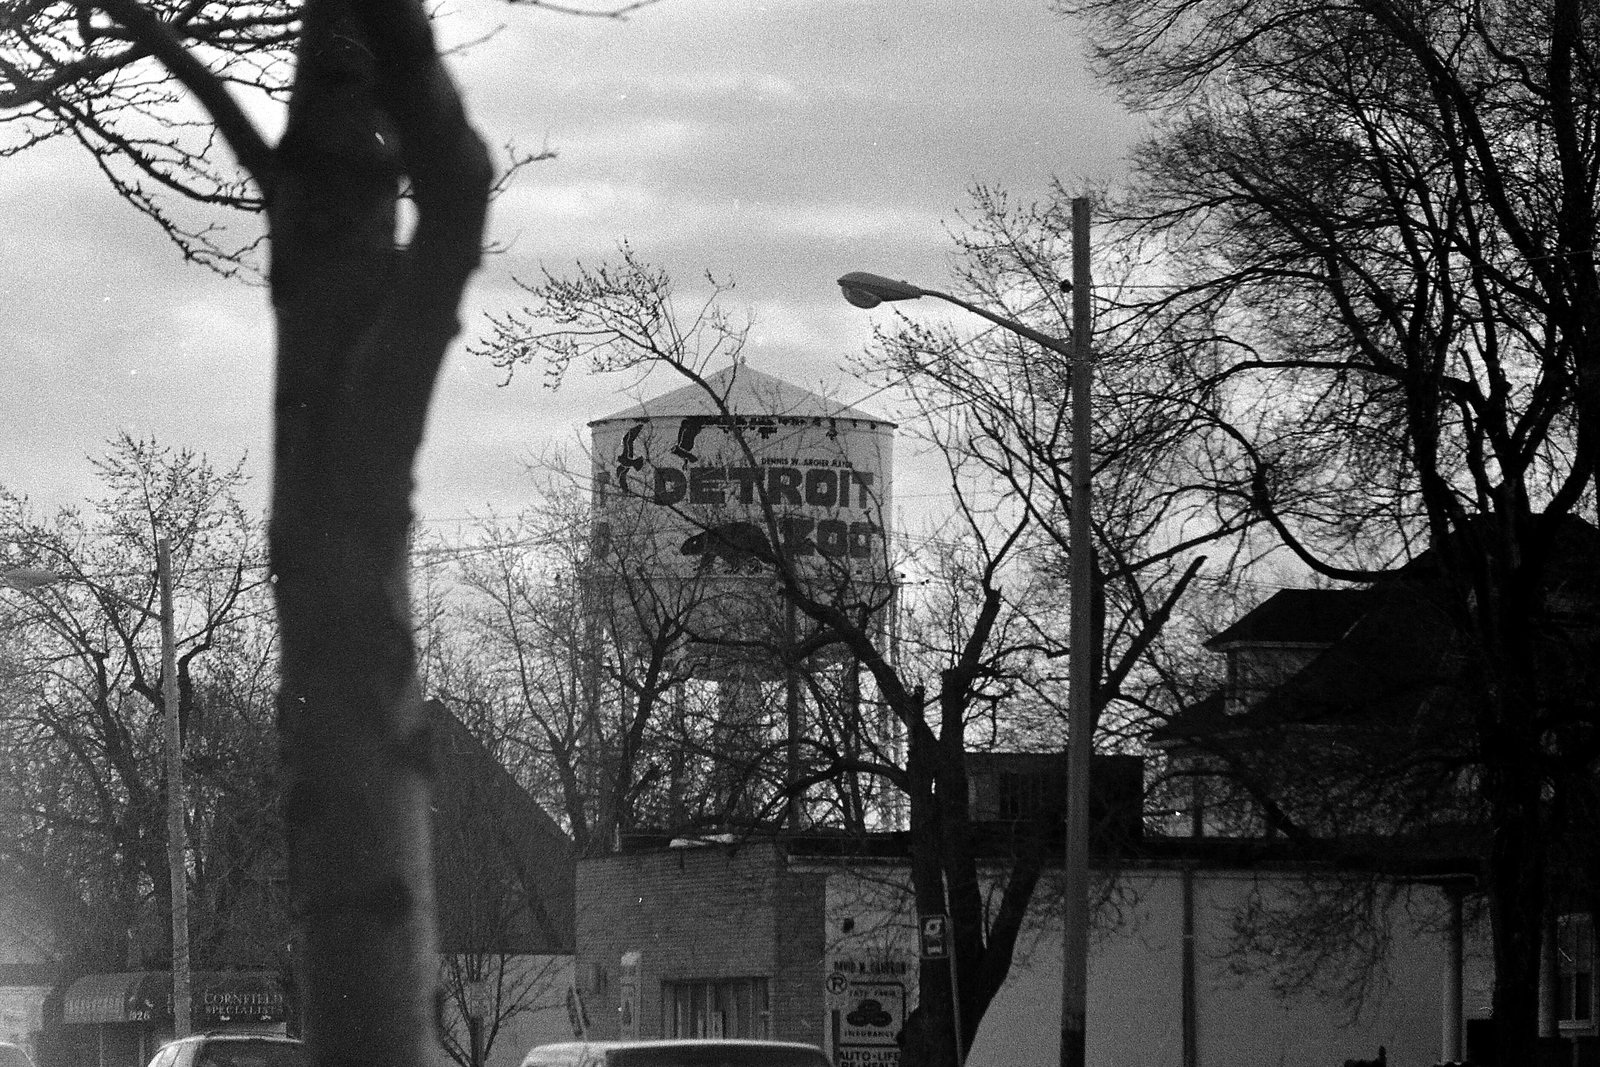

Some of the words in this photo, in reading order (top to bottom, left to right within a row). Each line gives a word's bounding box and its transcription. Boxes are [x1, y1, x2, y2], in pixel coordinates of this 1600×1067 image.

[761, 457, 788, 465] DENNIS
[653, 466, 875, 509] DETROIT
[778, 515, 874, 558] ZOO
